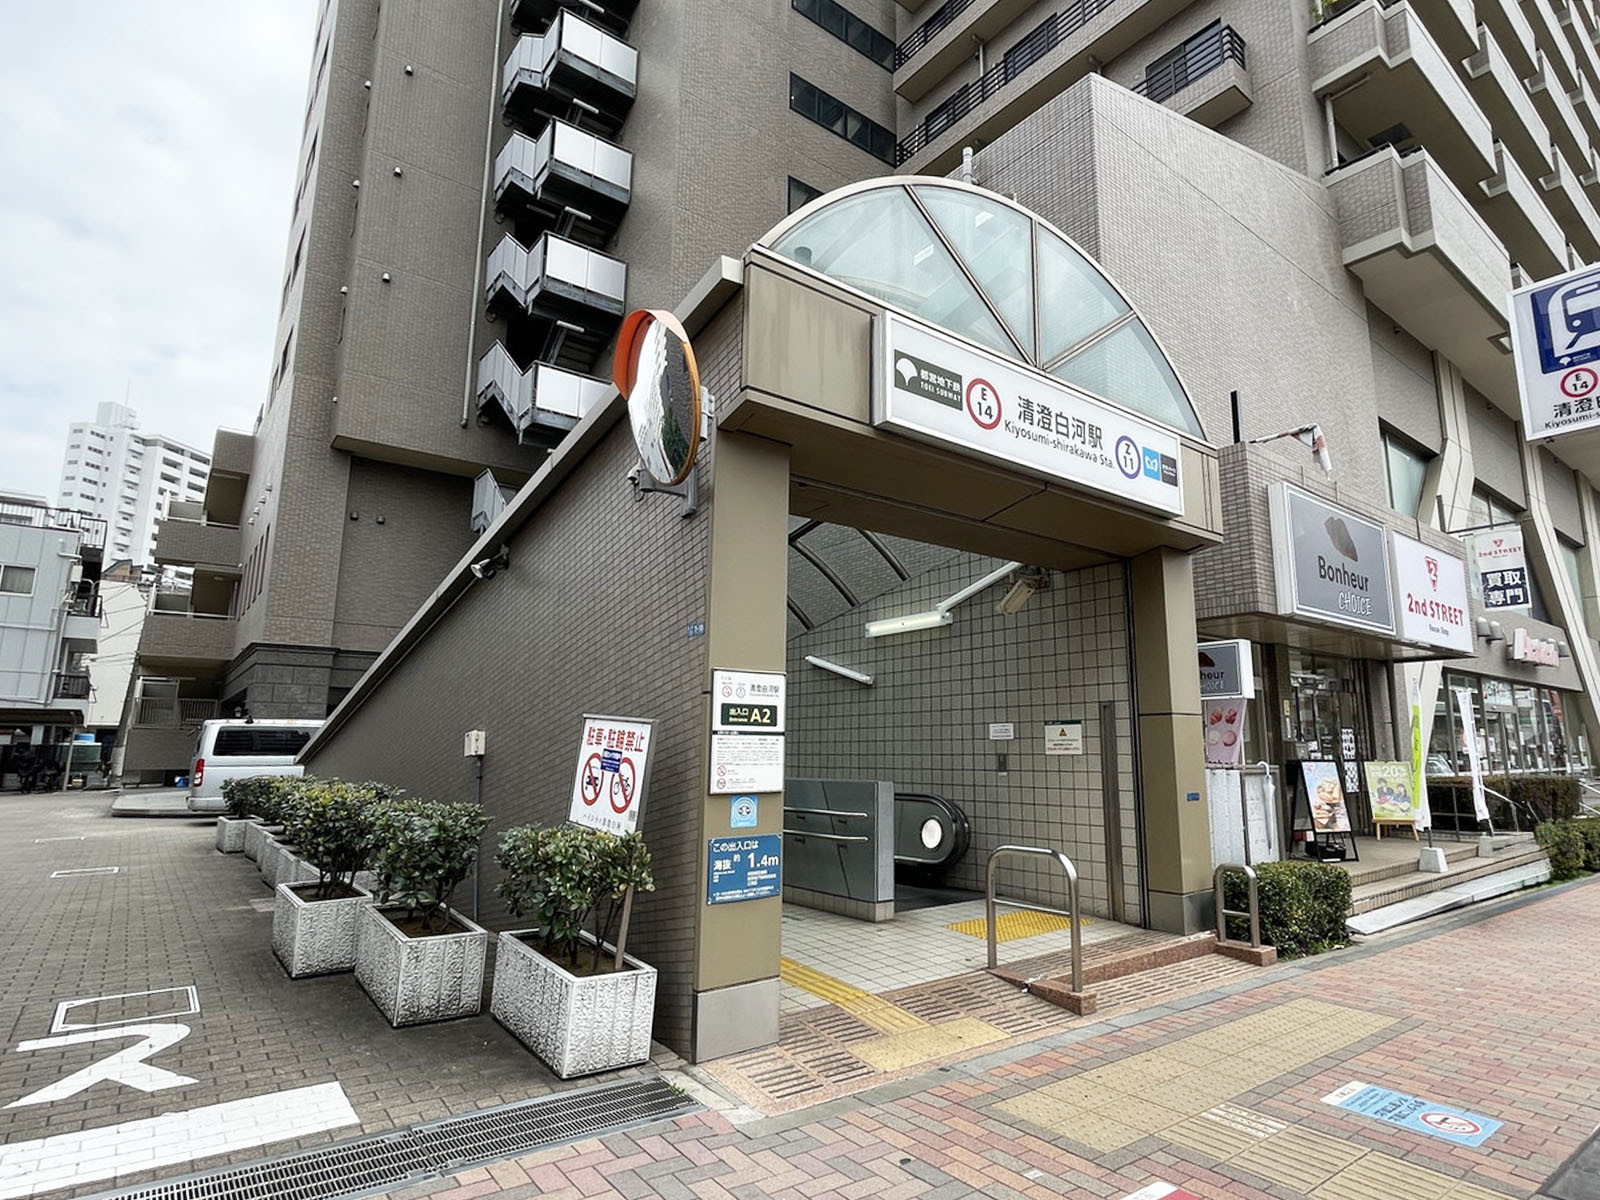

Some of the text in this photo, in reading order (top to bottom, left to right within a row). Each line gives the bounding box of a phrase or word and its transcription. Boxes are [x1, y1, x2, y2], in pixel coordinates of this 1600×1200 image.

[1575, 373, 1583, 381] E
[980, 387, 988, 401] E
[1572, 381, 1589, 391] 14
[976, 402, 993, 421] 14
[1553, 396, 1600, 418] 清澄
[1017, 394, 1103, 450] 清澄白河駅
[1004, 419, 1115, 470] Kiyosumi-shirakawa Sta.
[1124, 443, 1132, 456] Z
[1123, 455, 1134, 472] 11
[1317, 555, 1369, 592] Bonheur
[1486, 570, 1522, 588] 買取
[1338, 591, 1373, 616] CHOICE
[1488, 588, 1524, 605] 専門
[1407, 592, 1464, 627] 2nd STREET
[750, 707, 771, 724] A2
[713, 840, 759, 853] この出入口は
[747, 852, 779, 868] 1.4m
